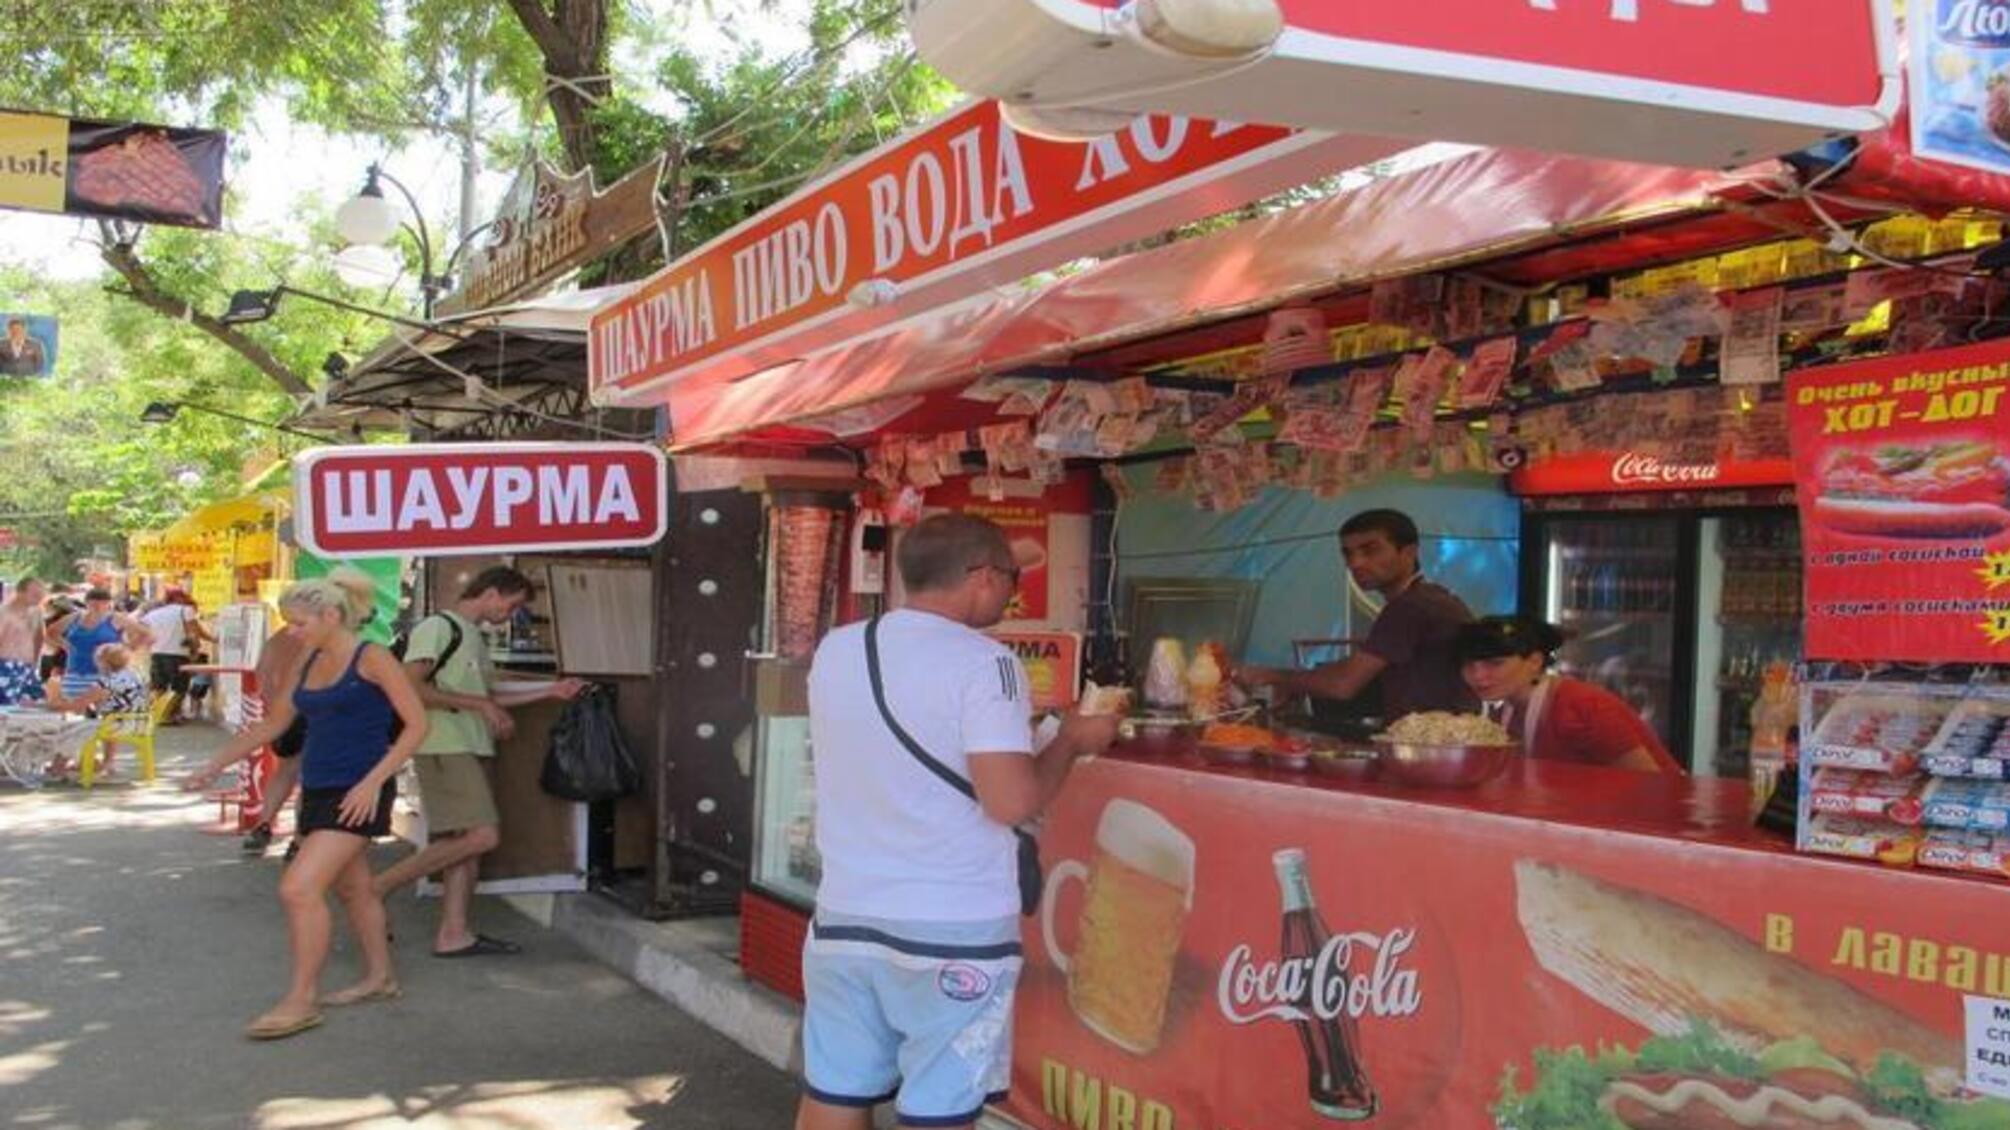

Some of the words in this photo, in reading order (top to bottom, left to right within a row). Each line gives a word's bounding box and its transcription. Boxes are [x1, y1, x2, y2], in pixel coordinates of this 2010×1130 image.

[602, 266, 717, 382] ШАУРМА
[732, 202, 847, 330] ПИВО
[867, 117, 1034, 260] ВОДА
[1797, 381, 1883, 405] Очень
[324, 464, 641, 533] ШАУРМА
[1217, 930, 1422, 1024] Coca-Cola
